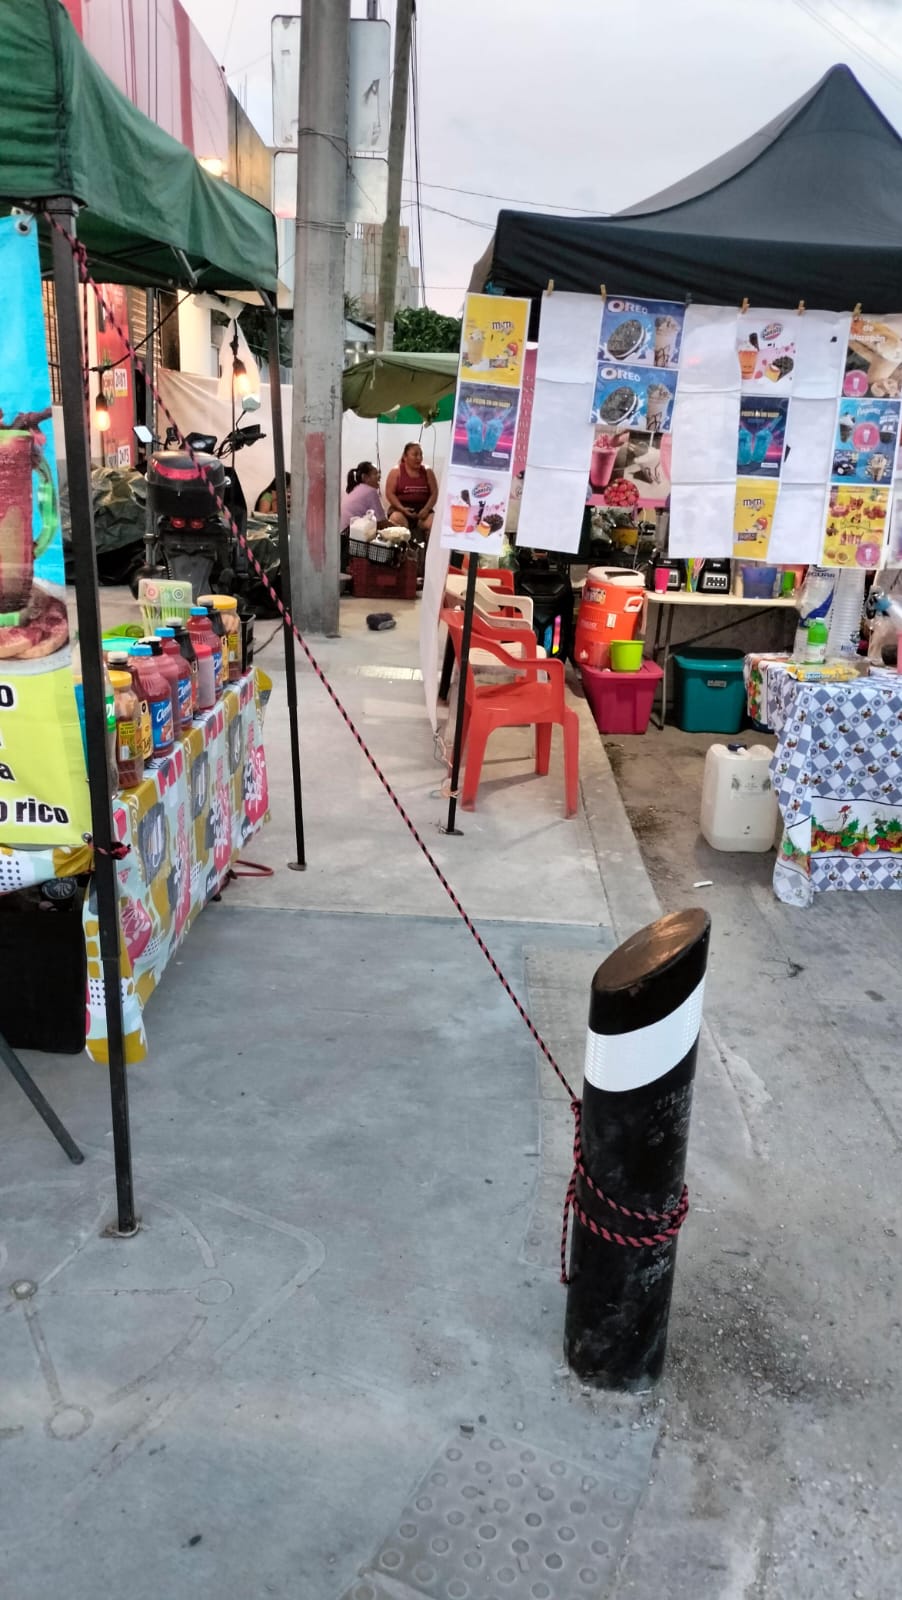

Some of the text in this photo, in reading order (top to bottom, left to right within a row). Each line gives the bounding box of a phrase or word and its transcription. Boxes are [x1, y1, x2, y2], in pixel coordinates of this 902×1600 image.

[607, 300, 648, 315] OREO
[600, 367, 641, 382] OREO
[15, 798, 69, 824] rico
